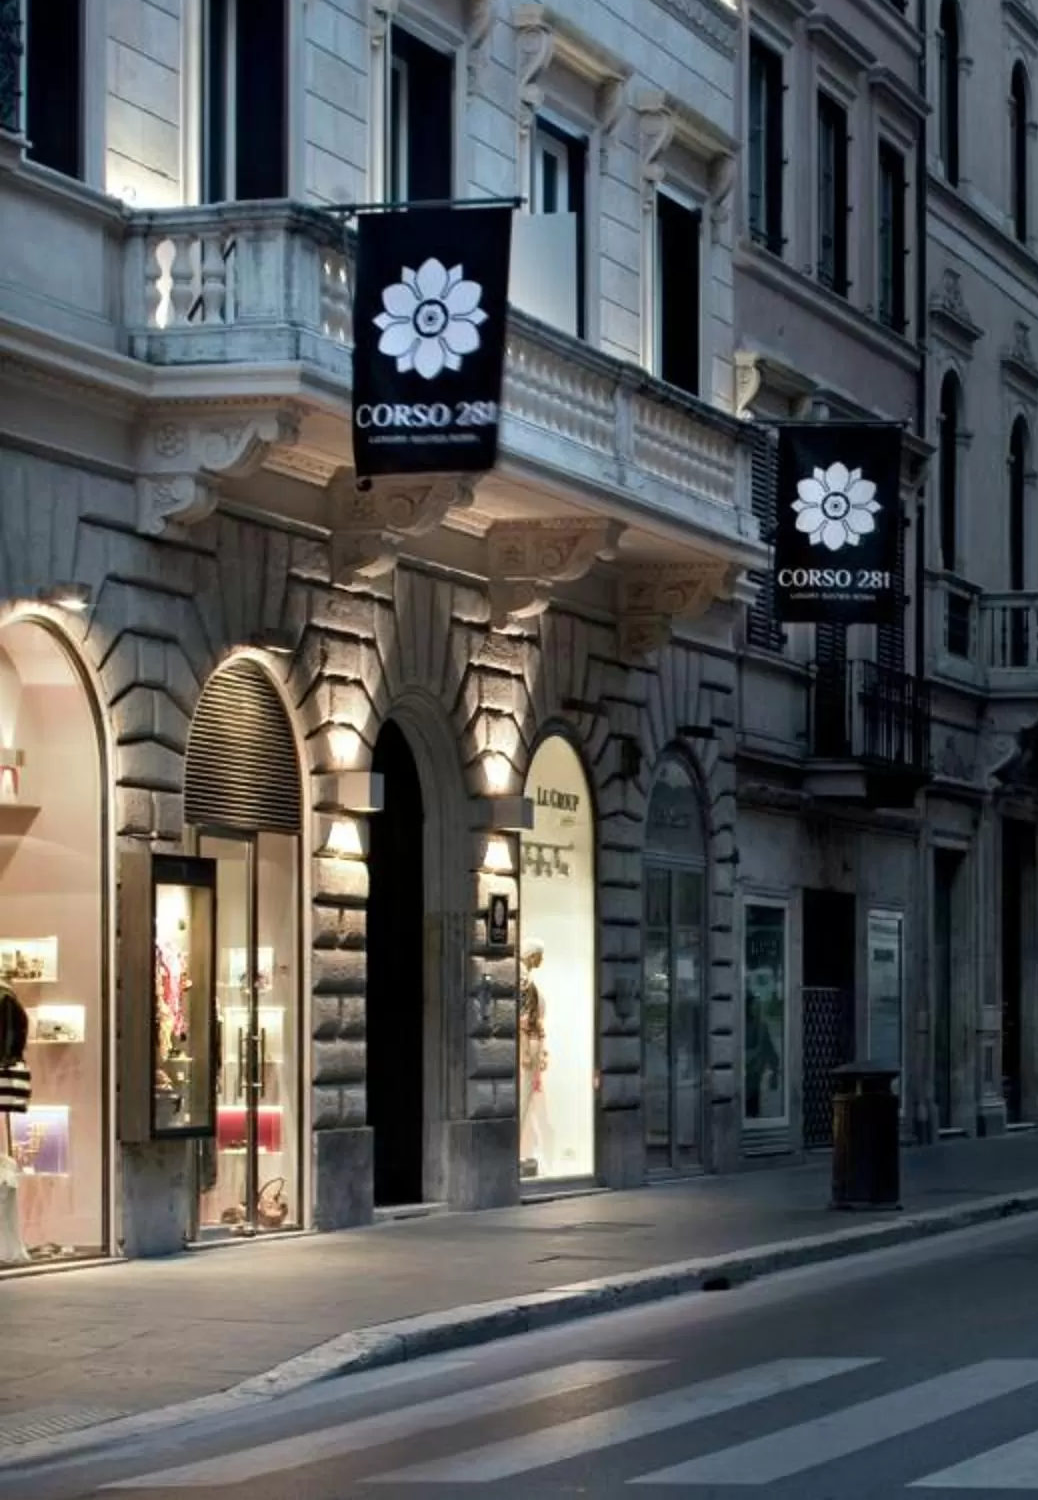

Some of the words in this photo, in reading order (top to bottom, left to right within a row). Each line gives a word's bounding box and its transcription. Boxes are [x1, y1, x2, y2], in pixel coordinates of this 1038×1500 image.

[356, 403, 452, 428] CORSO
[455, 401, 498, 427] 281
[778, 568, 852, 588] CORSO
[857, 569, 891, 589] 281
